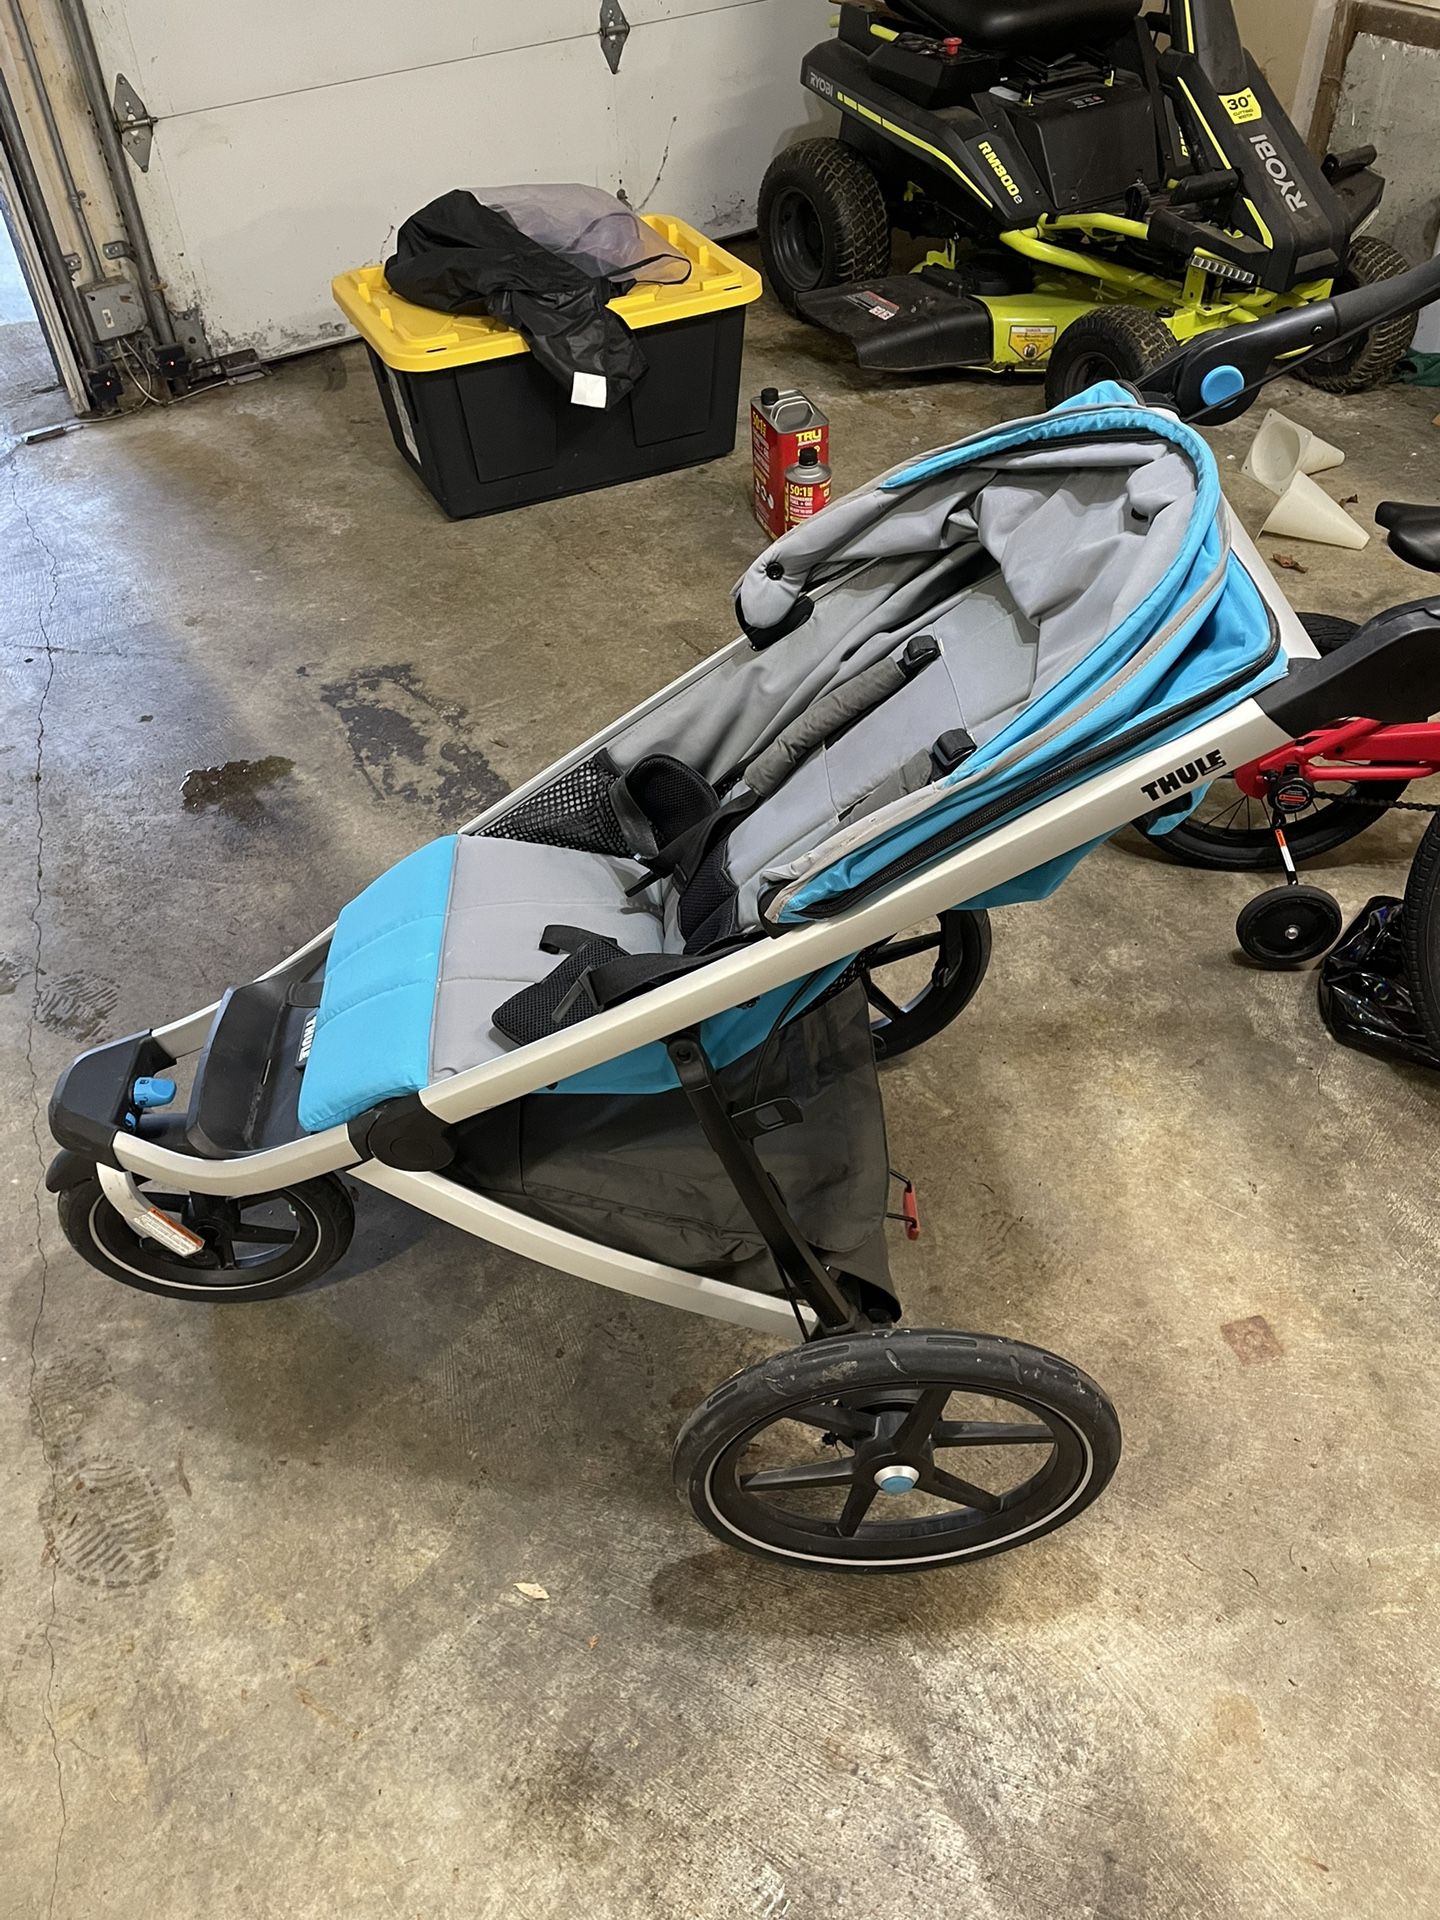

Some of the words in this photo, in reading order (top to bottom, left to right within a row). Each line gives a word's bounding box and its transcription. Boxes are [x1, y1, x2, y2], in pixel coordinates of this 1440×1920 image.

[810, 71, 834, 97] RYOBI
[1227, 94, 1251, 110] 30"
[1249, 134, 1308, 212] RYOBI
[790, 484, 807, 497] 50:1
[1140, 749, 1227, 801] THULE
